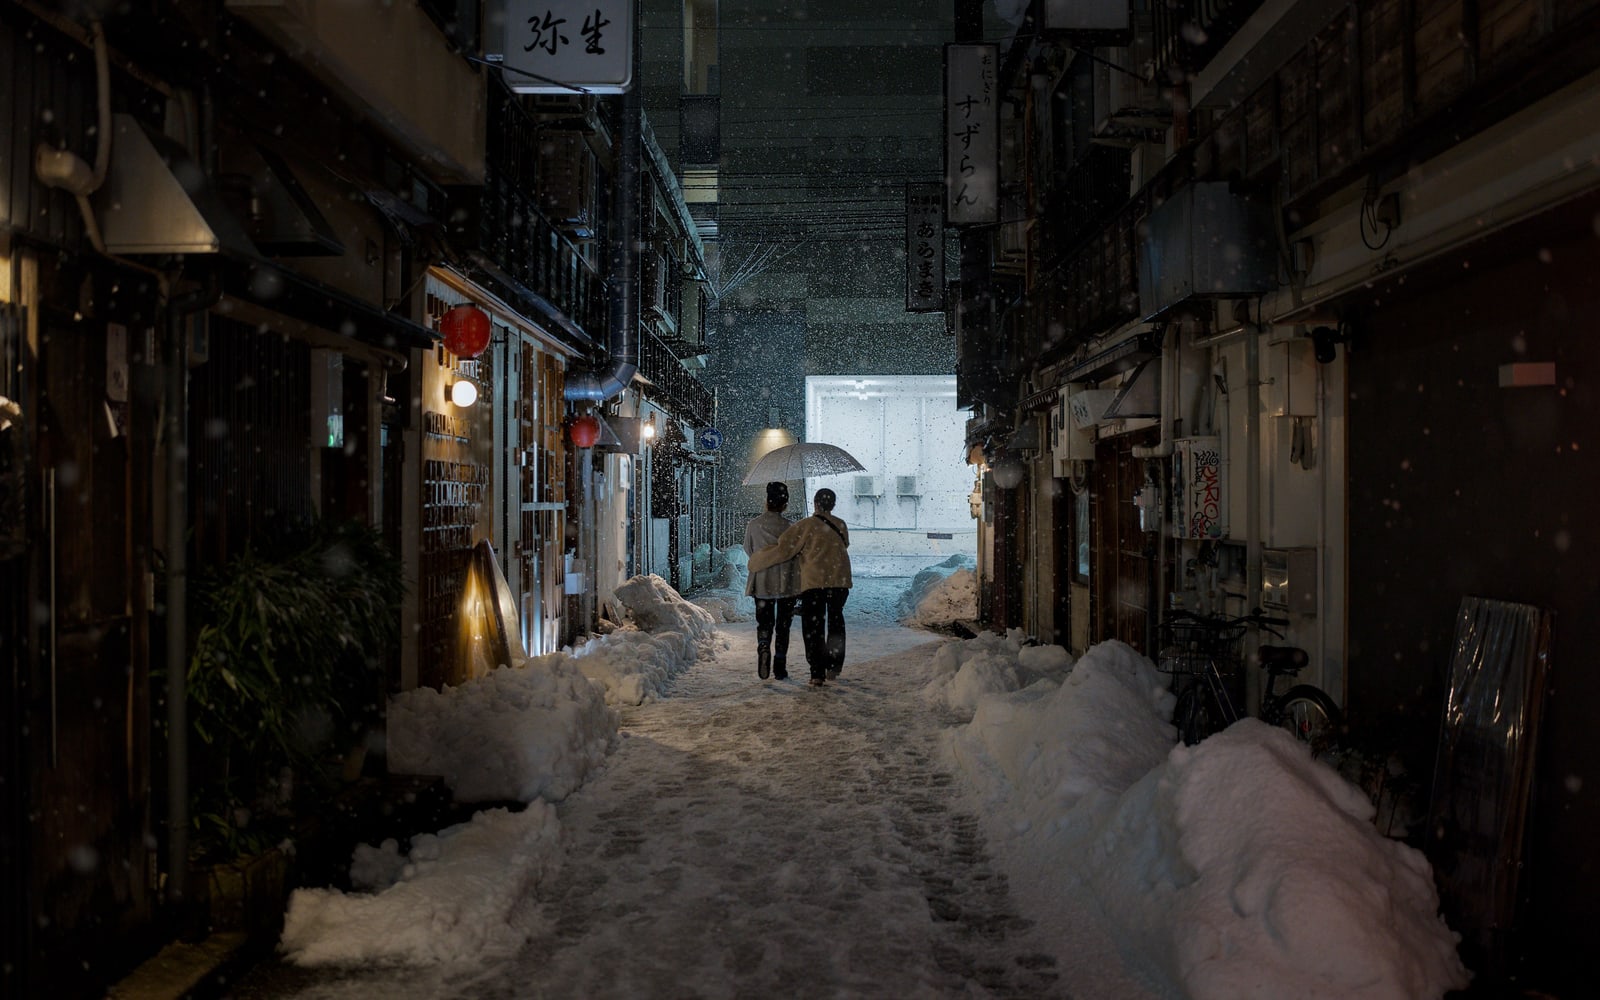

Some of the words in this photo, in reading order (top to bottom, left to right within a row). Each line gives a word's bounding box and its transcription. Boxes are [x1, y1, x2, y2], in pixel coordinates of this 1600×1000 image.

[524, 9, 611, 55] 弥生
[982, 54, 993, 106] おにぎり
[953, 95, 981, 206] すずらん
[917, 221, 935, 298] あらまき
